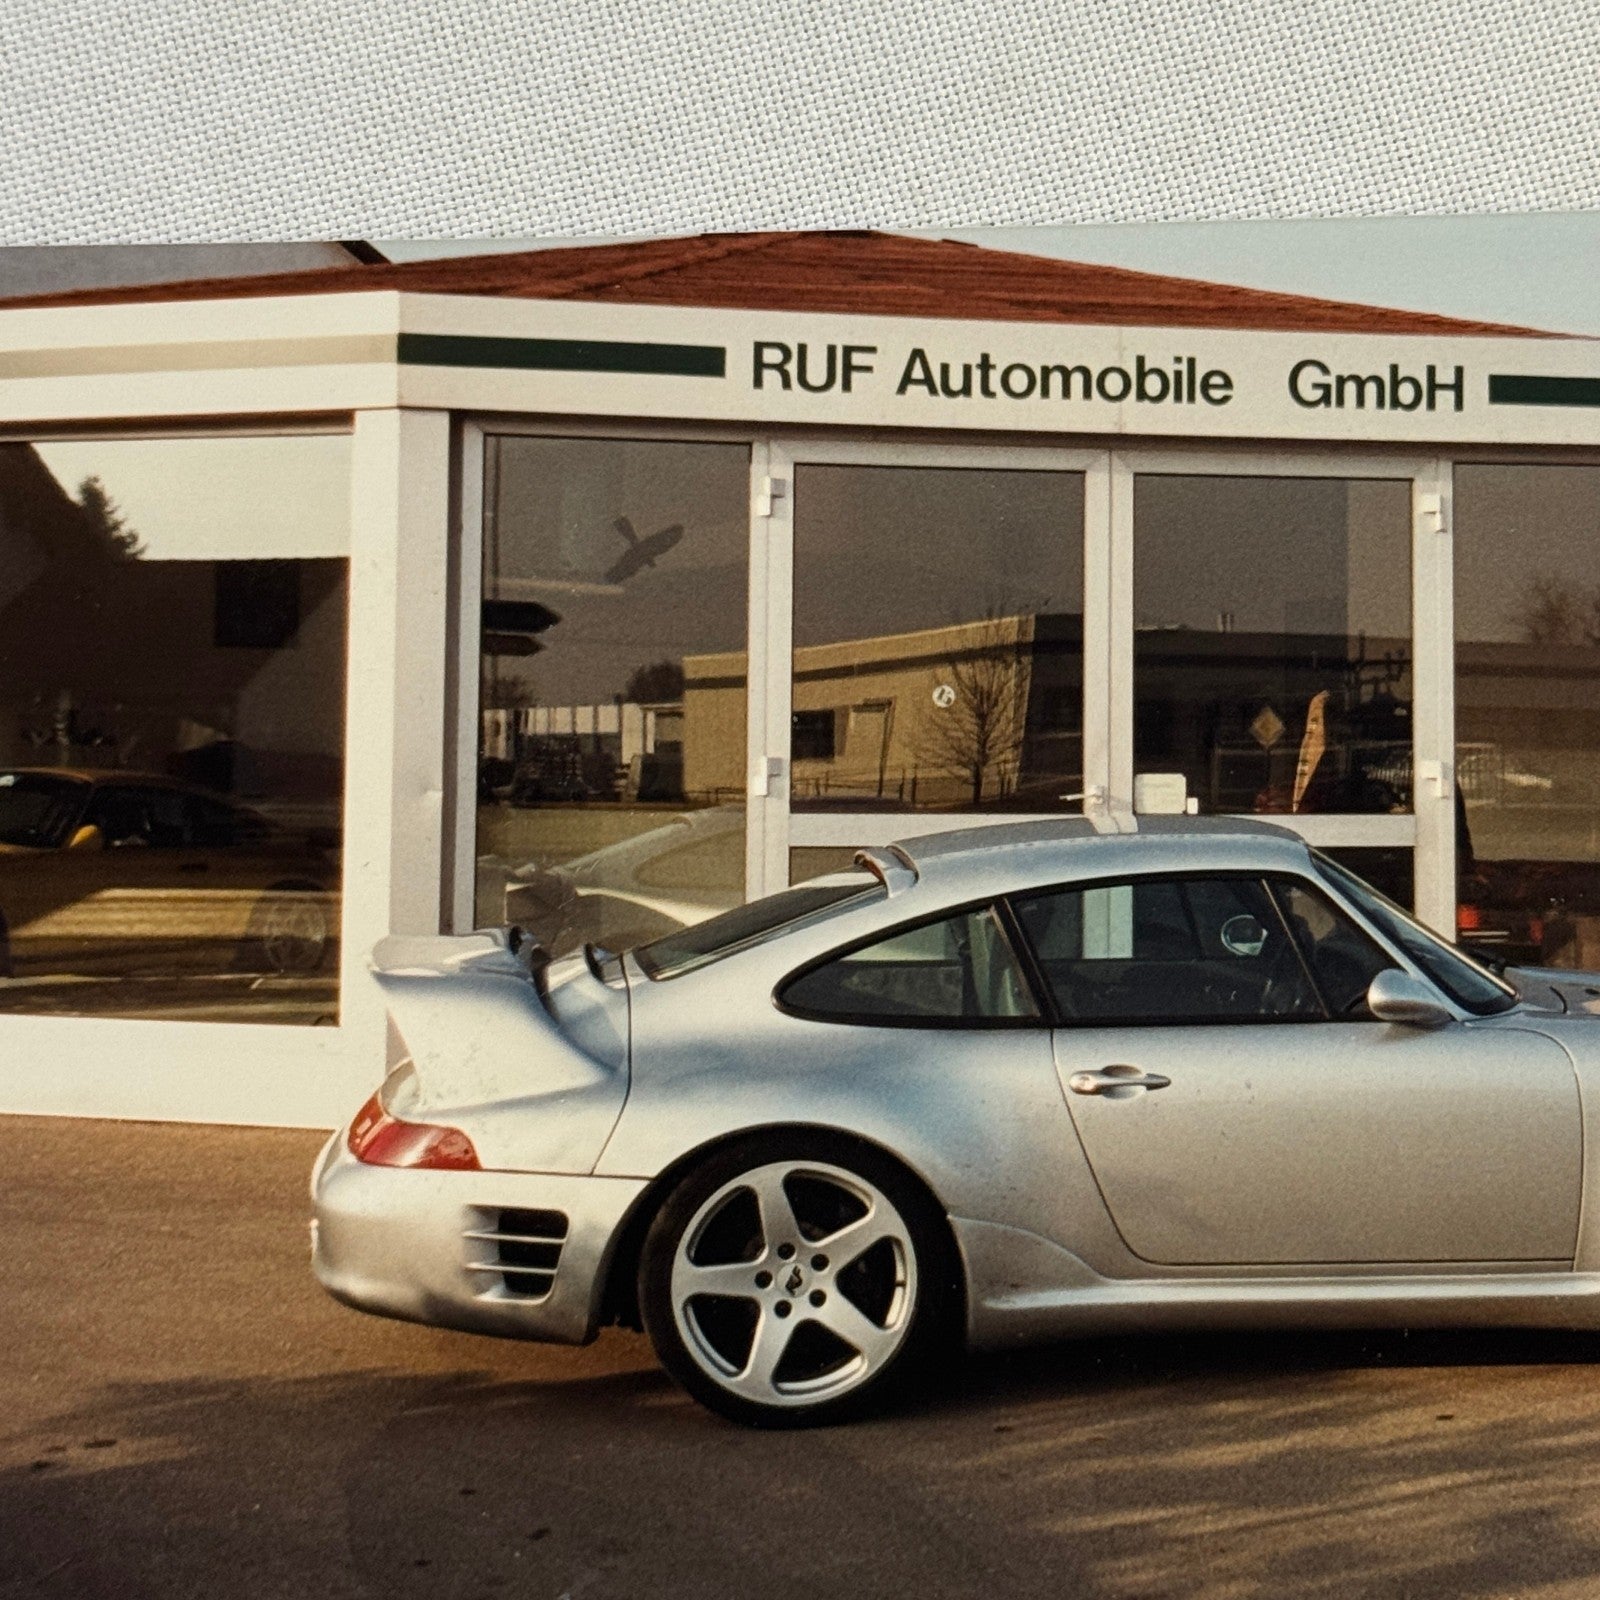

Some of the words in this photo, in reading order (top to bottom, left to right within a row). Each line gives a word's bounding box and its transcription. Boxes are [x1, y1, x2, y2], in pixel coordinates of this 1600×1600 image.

[752, 341, 878, 393] RUF
[896, 348, 1234, 406] Automobile
[1288, 359, 1464, 412] GmbH
